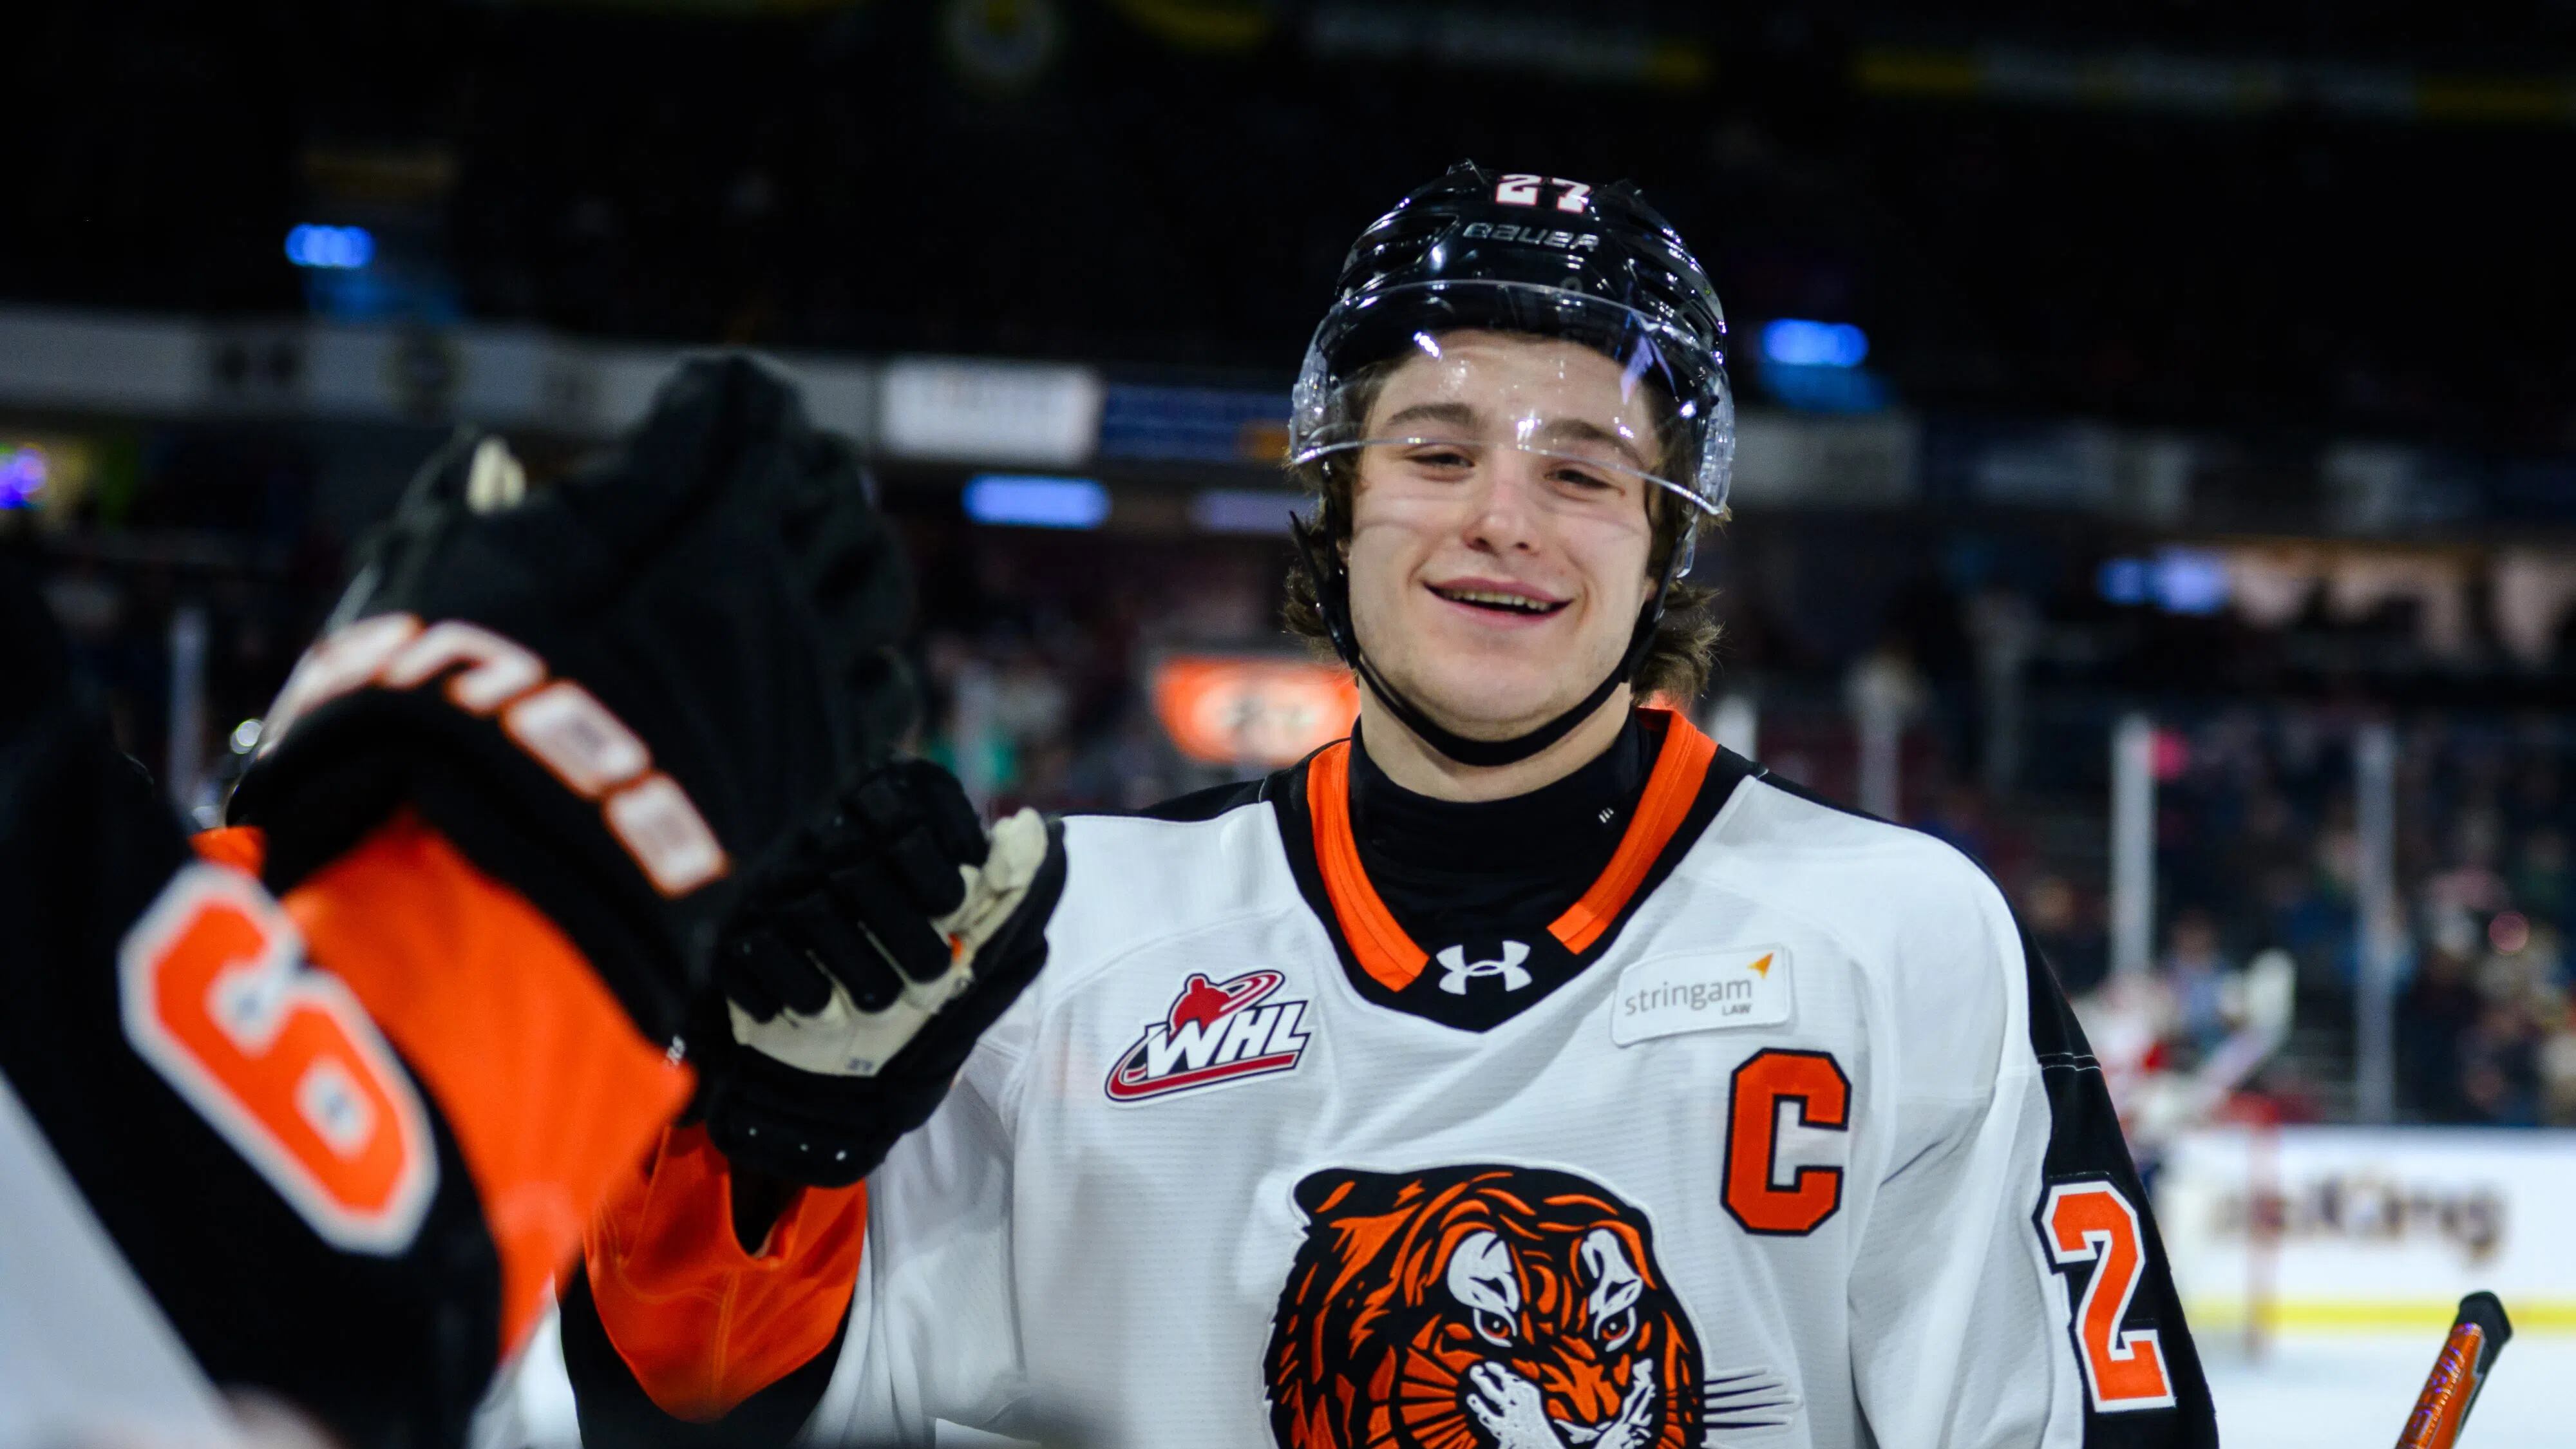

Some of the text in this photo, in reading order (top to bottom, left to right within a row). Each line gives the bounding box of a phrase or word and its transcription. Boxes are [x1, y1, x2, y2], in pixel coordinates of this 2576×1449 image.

[1495, 173, 1591, 214] 27
[1462, 222, 1600, 252] BAUER
[1624, 979, 1752, 1017] stringam
[1721, 1001, 1754, 1017] LAW
[117, 858, 440, 1256] 6
[1145, 999, 1311, 1081] WHL
[1719, 1046, 1853, 1237] C
[2040, 1180, 2178, 1414] 2
